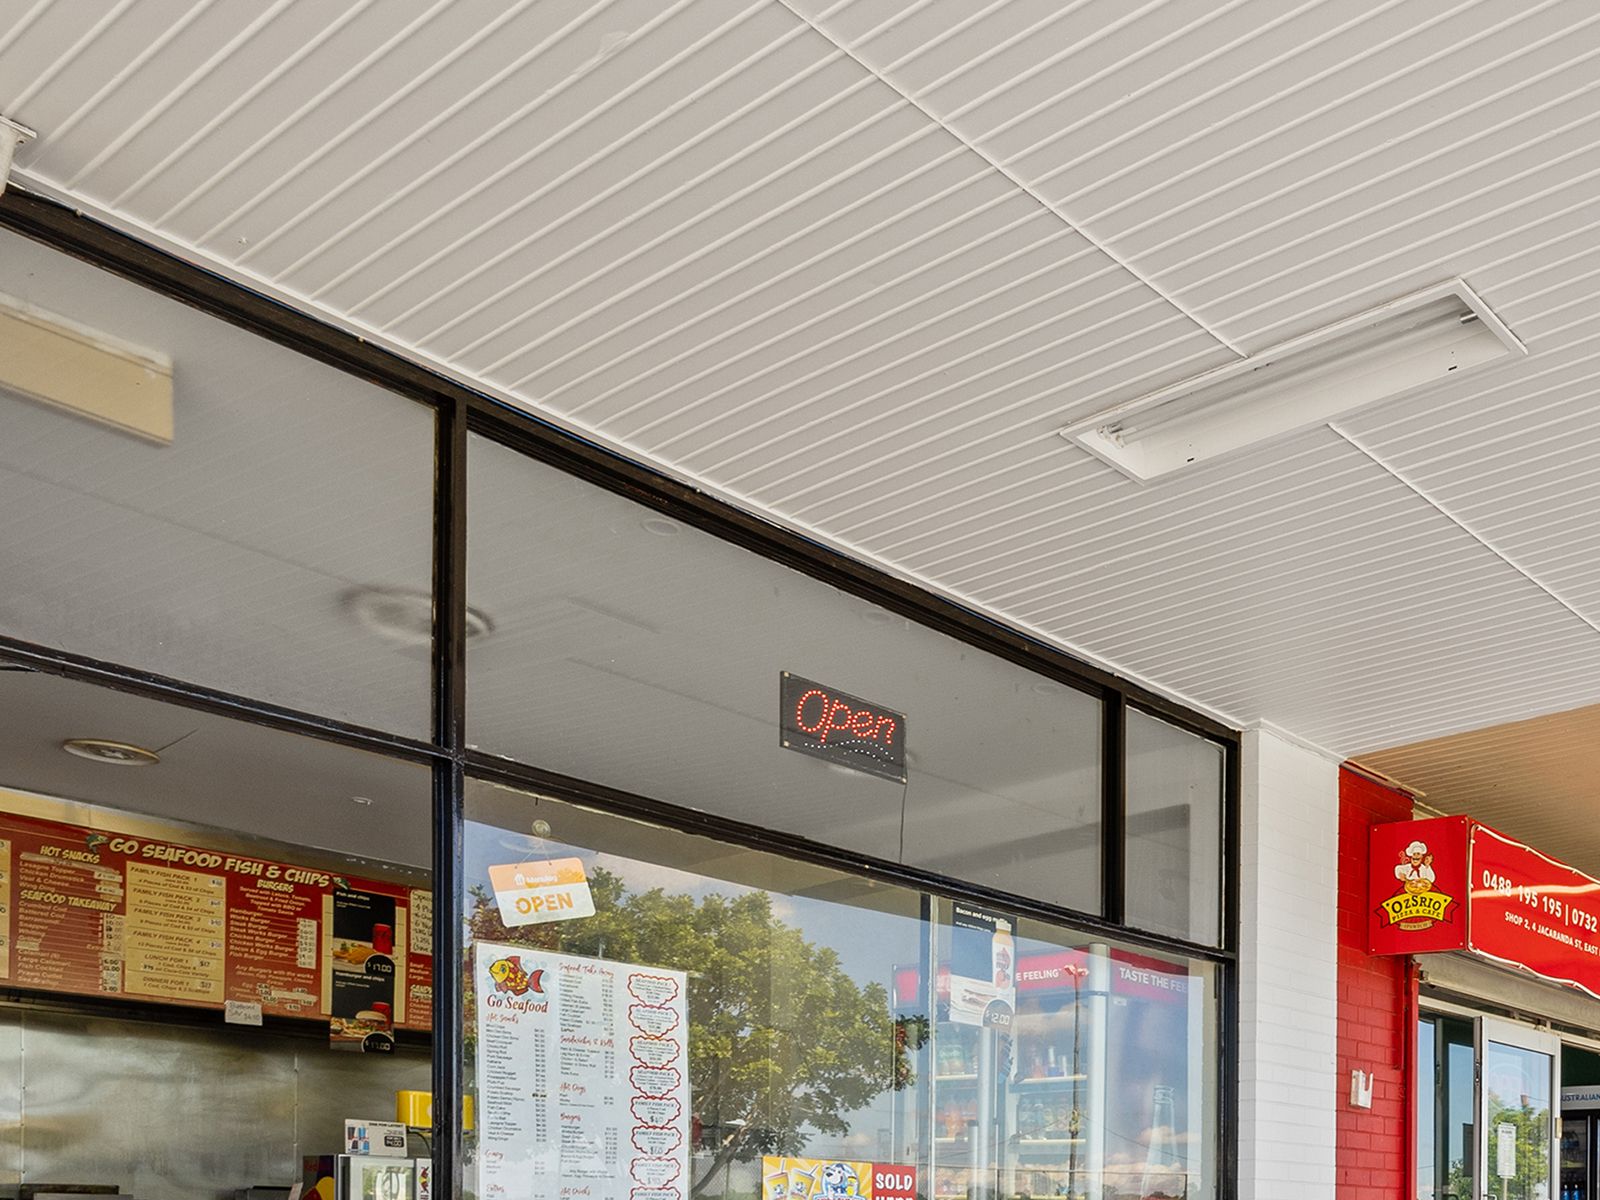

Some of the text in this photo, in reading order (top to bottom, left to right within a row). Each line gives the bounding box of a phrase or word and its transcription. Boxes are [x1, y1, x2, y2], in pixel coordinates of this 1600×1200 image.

[796, 689, 897, 744] Open
[40, 845, 100, 864] HOT SNACKS
[109, 837, 331, 888] GO SEAFOOD FISH & CHIPS
[130, 866, 191, 881] FAMILY FISH PACK
[133, 887, 193, 902] FAMILY FISH PACK
[256, 879, 294, 893] BURGERS
[20, 889, 117, 913] SEAFOOD TAKEAWAY
[515, 892, 574, 915] OPEN
[1482, 869, 1512, 897] 0488
[1518, 884, 1538, 909] 195
[1542, 895, 1562, 918] 195
[1571, 908, 1598, 933] 0732
[133, 907, 194, 921] FAMILY FISH PACK
[955, 906, 972, 917] Bacon
[972, 911, 982, 919] and
[982, 914, 992, 922] egg
[1392, 909, 1413, 921] PIZZA
[133, 930, 193, 944] FAMILY FISH PACK
[1504, 911, 1524, 926] SHOP
[1524, 919, 1531, 931] 2,
[1537, 925, 1574, 946] JACARANDA
[1574, 938, 1583, 950] ST,
[1584, 943, 1599, 956] EAST
[1023, 969, 1060, 981] FEELING
[1119, 967, 1149, 985] TASTE
[1150, 974, 1169, 990] THE
[487, 994, 549, 1014] Go Seafood
[875, 1172, 913, 1191] SOLD
